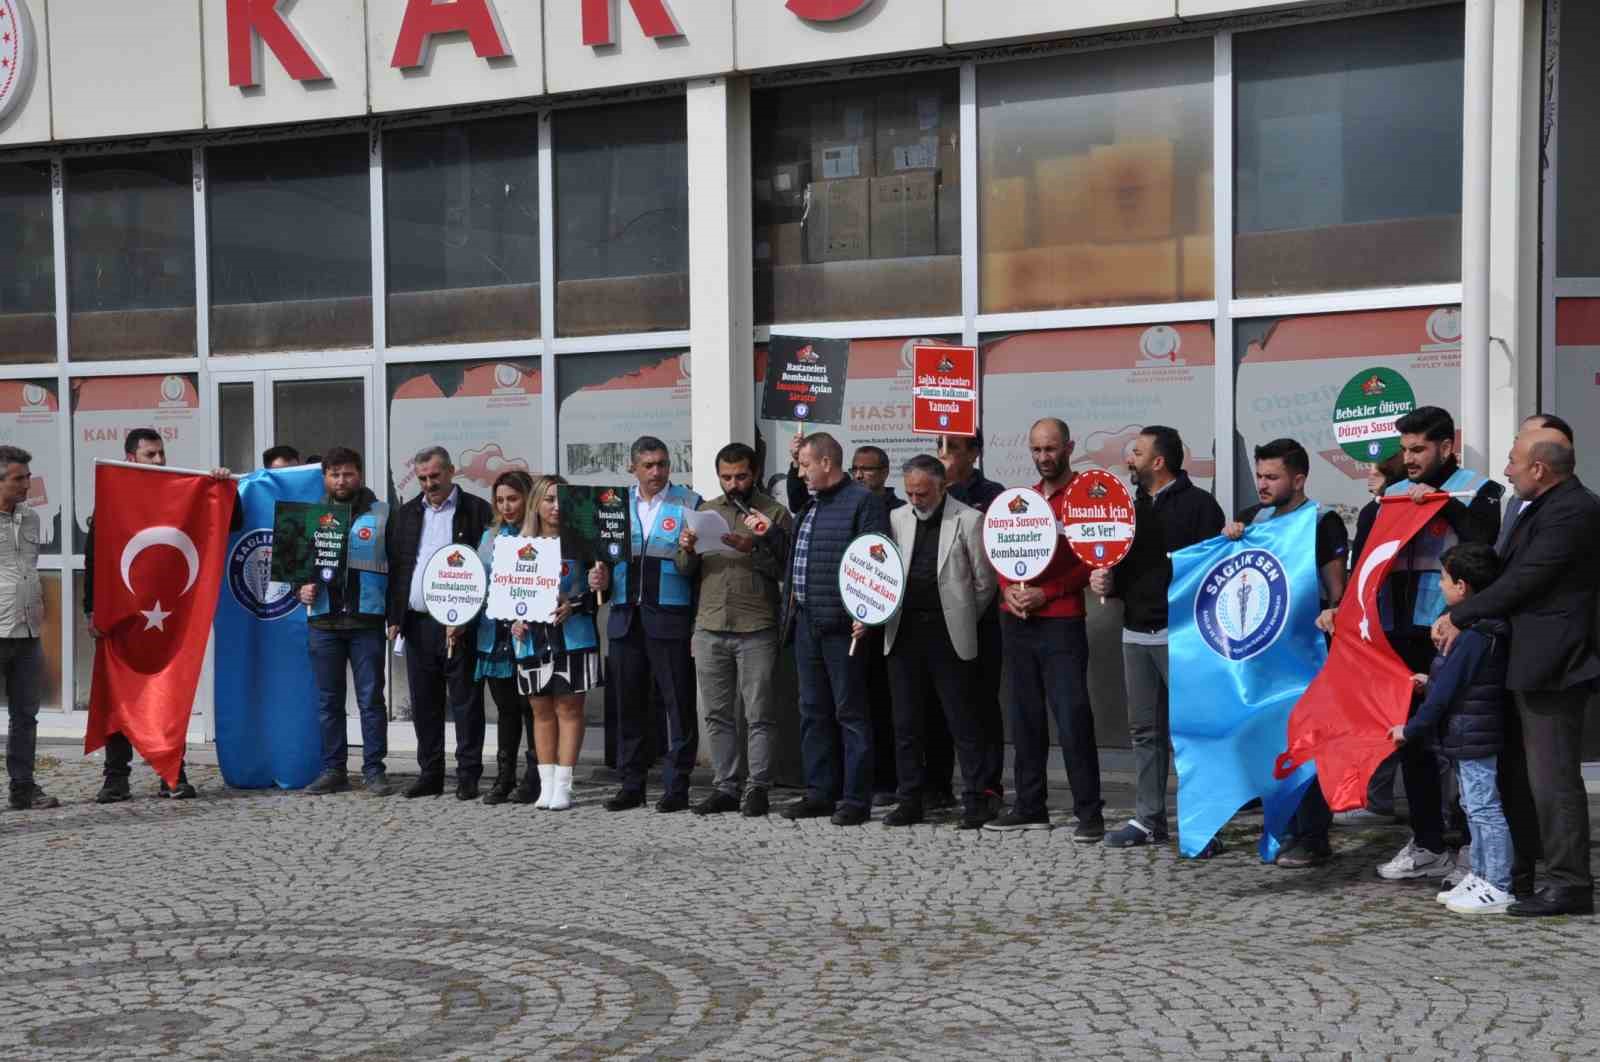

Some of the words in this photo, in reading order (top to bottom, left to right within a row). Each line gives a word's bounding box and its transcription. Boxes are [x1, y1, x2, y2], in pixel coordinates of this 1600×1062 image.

[809, 383, 832, 395] Açılan
[850, 404, 911, 419] HAST
[928, 400, 960, 413] Yanında
[1335, 404, 1377, 420] Bebekler
[1379, 400, 1413, 415] Ölüyor,
[84, 427, 118, 442] KAN
[1338, 422, 1368, 438] Dünya
[1370, 421, 1398, 433] Susuy
[1068, 502, 1106, 519] İnsanlık
[1109, 501, 1128, 522] İçin
[988, 517, 1014, 531] Dünya
[1016, 516, 1051, 530] Susuyor,
[1081, 525, 1096, 537] Ses
[1098, 525, 1116, 537] Ver!
[997, 532, 1042, 544] Hastaneler
[991, 547, 1049, 561] Bombalanıyor
[1255, 555, 1280, 583] SEN
[493, 574, 535, 588] Soykırım
[536, 575, 557, 590] Suçu
[509, 586, 538, 600] İşliyor
